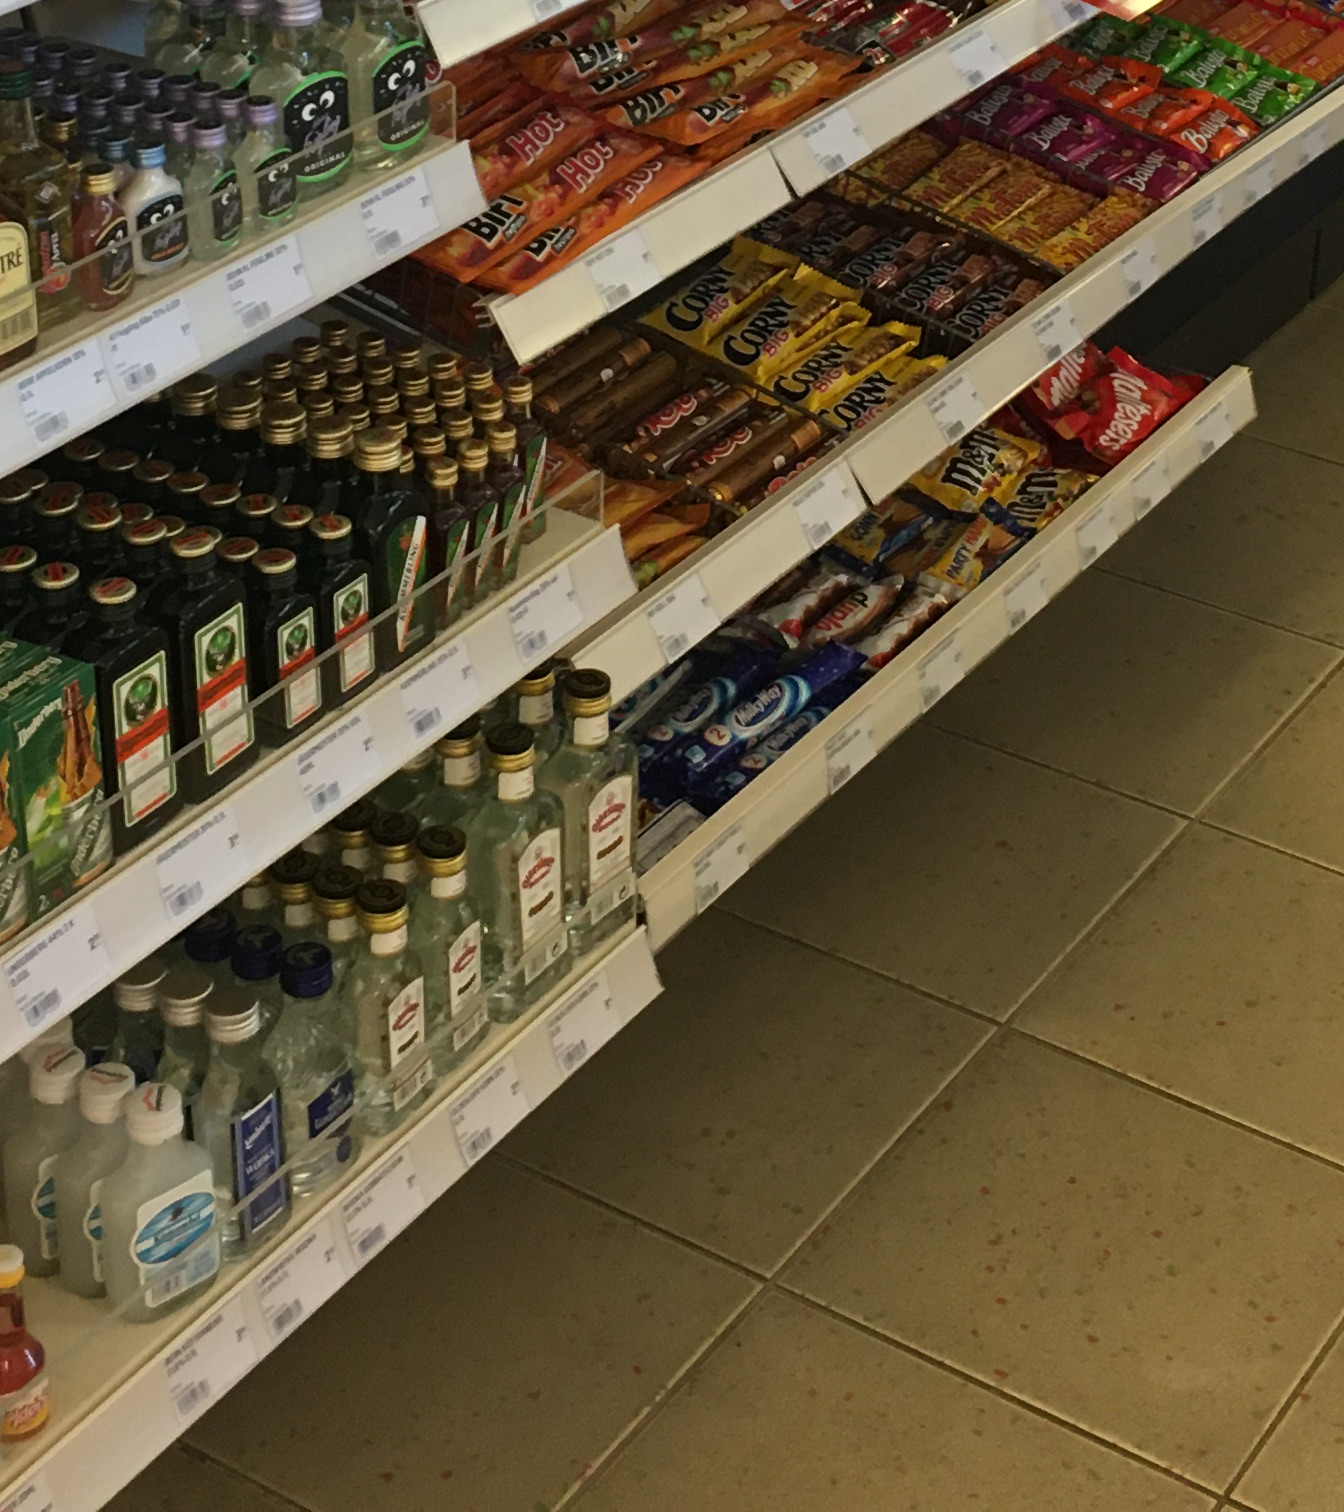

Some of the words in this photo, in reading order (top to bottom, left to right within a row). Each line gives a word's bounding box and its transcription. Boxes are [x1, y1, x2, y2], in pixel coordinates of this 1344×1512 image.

[506, 111, 565, 164] HOT
[555, 136, 616, 194] HOT
[665, 265, 737, 332] CORNY
[704, 293, 730, 324] BIG
[722, 295, 798, 366] CORNY
[762, 326, 790, 360] BIG
[773, 339, 854, 404] CORNY
[811, 365, 844, 394] BIG
